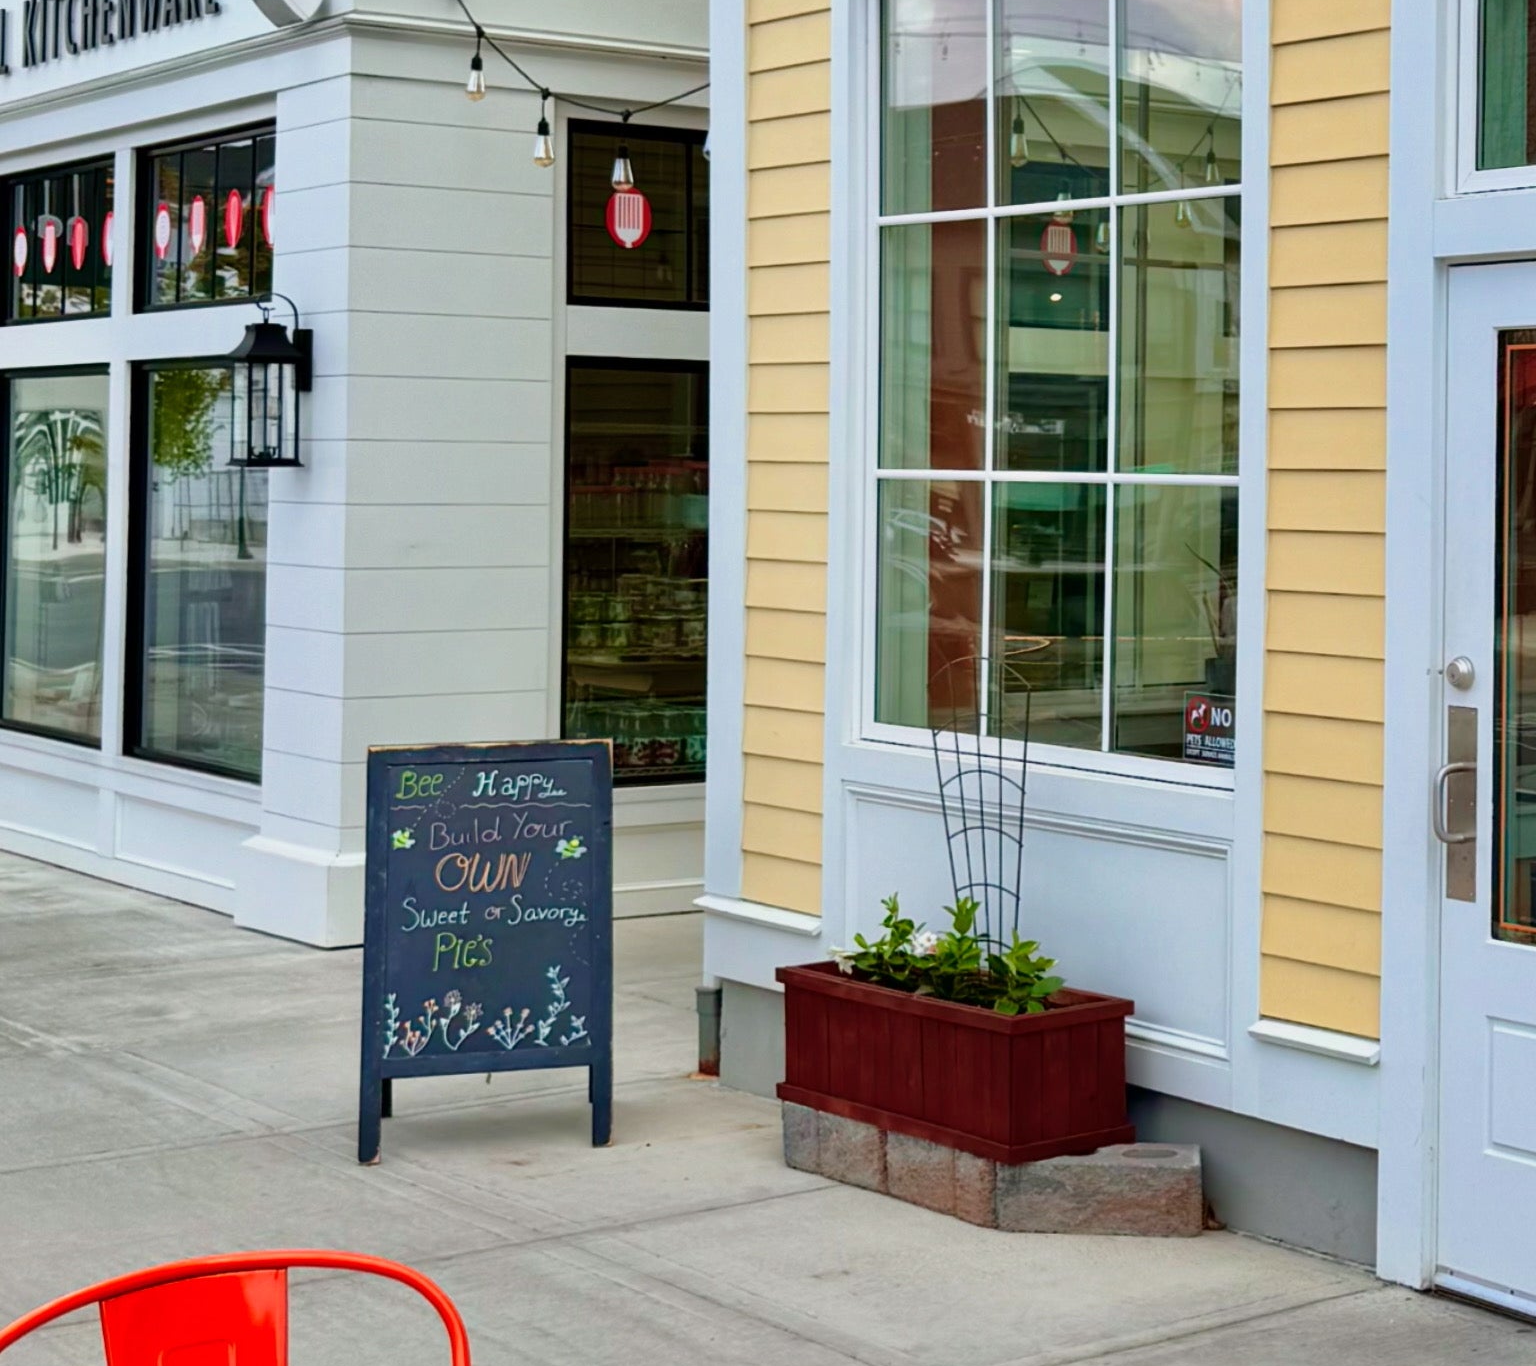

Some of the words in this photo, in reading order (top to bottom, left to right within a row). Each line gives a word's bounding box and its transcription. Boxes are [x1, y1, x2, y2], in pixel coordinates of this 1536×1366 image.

[1211, 707, 1232, 727] NO
[395, 771, 443, 799] Bee
[430, 816, 502, 851] Build
[513, 811, 573, 839] Your
[435, 852, 531, 892] OWN
[402, 897, 470, 931] Sweet
[485, 905, 506, 921] or
